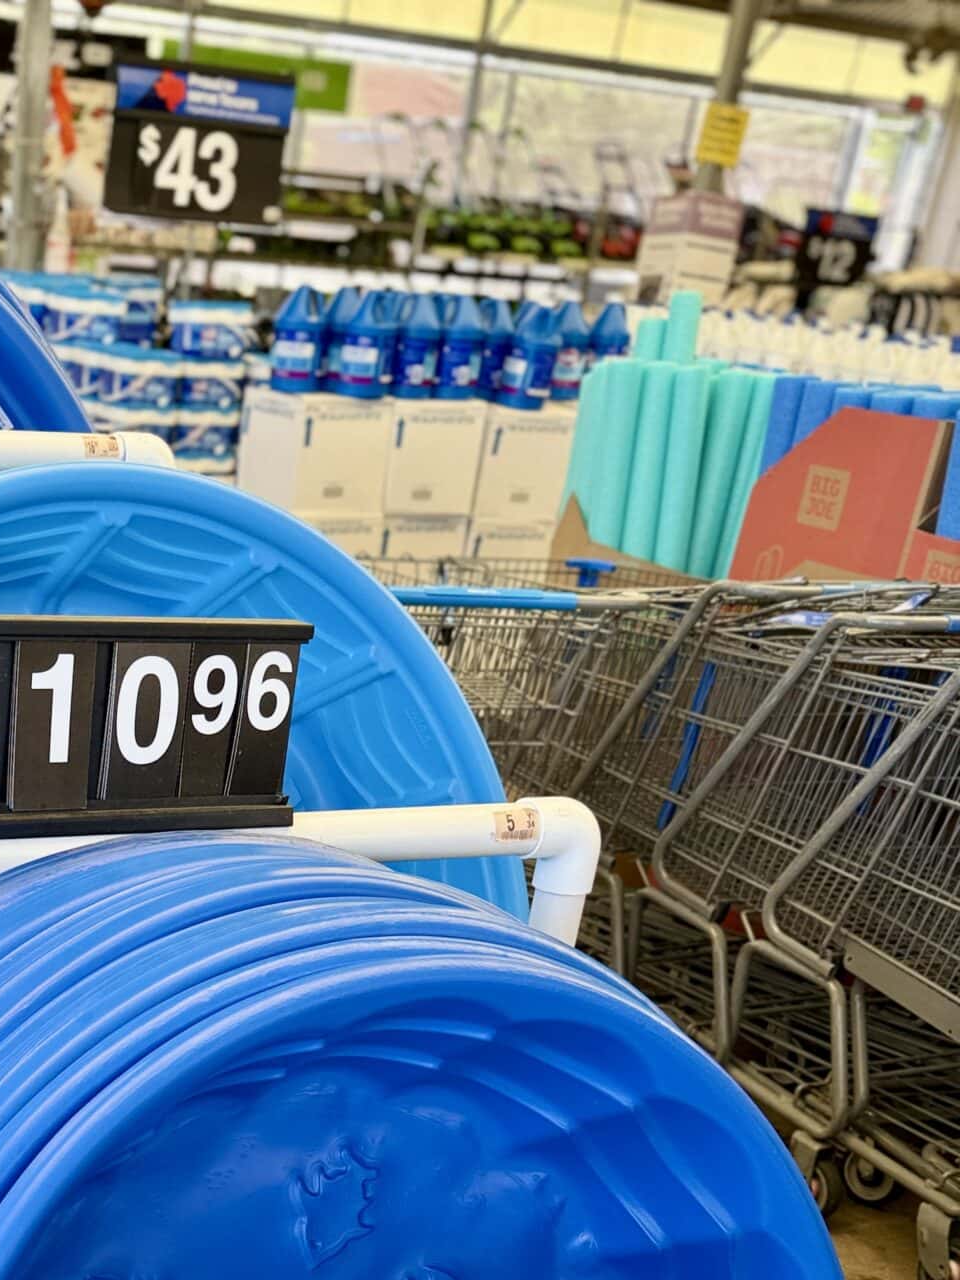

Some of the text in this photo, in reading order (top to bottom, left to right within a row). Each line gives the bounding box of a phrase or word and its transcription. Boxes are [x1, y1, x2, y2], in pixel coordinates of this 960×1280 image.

[137, 123, 239, 213] $43
[810, 475, 841, 497] BIG
[806, 497, 837, 521] JOE
